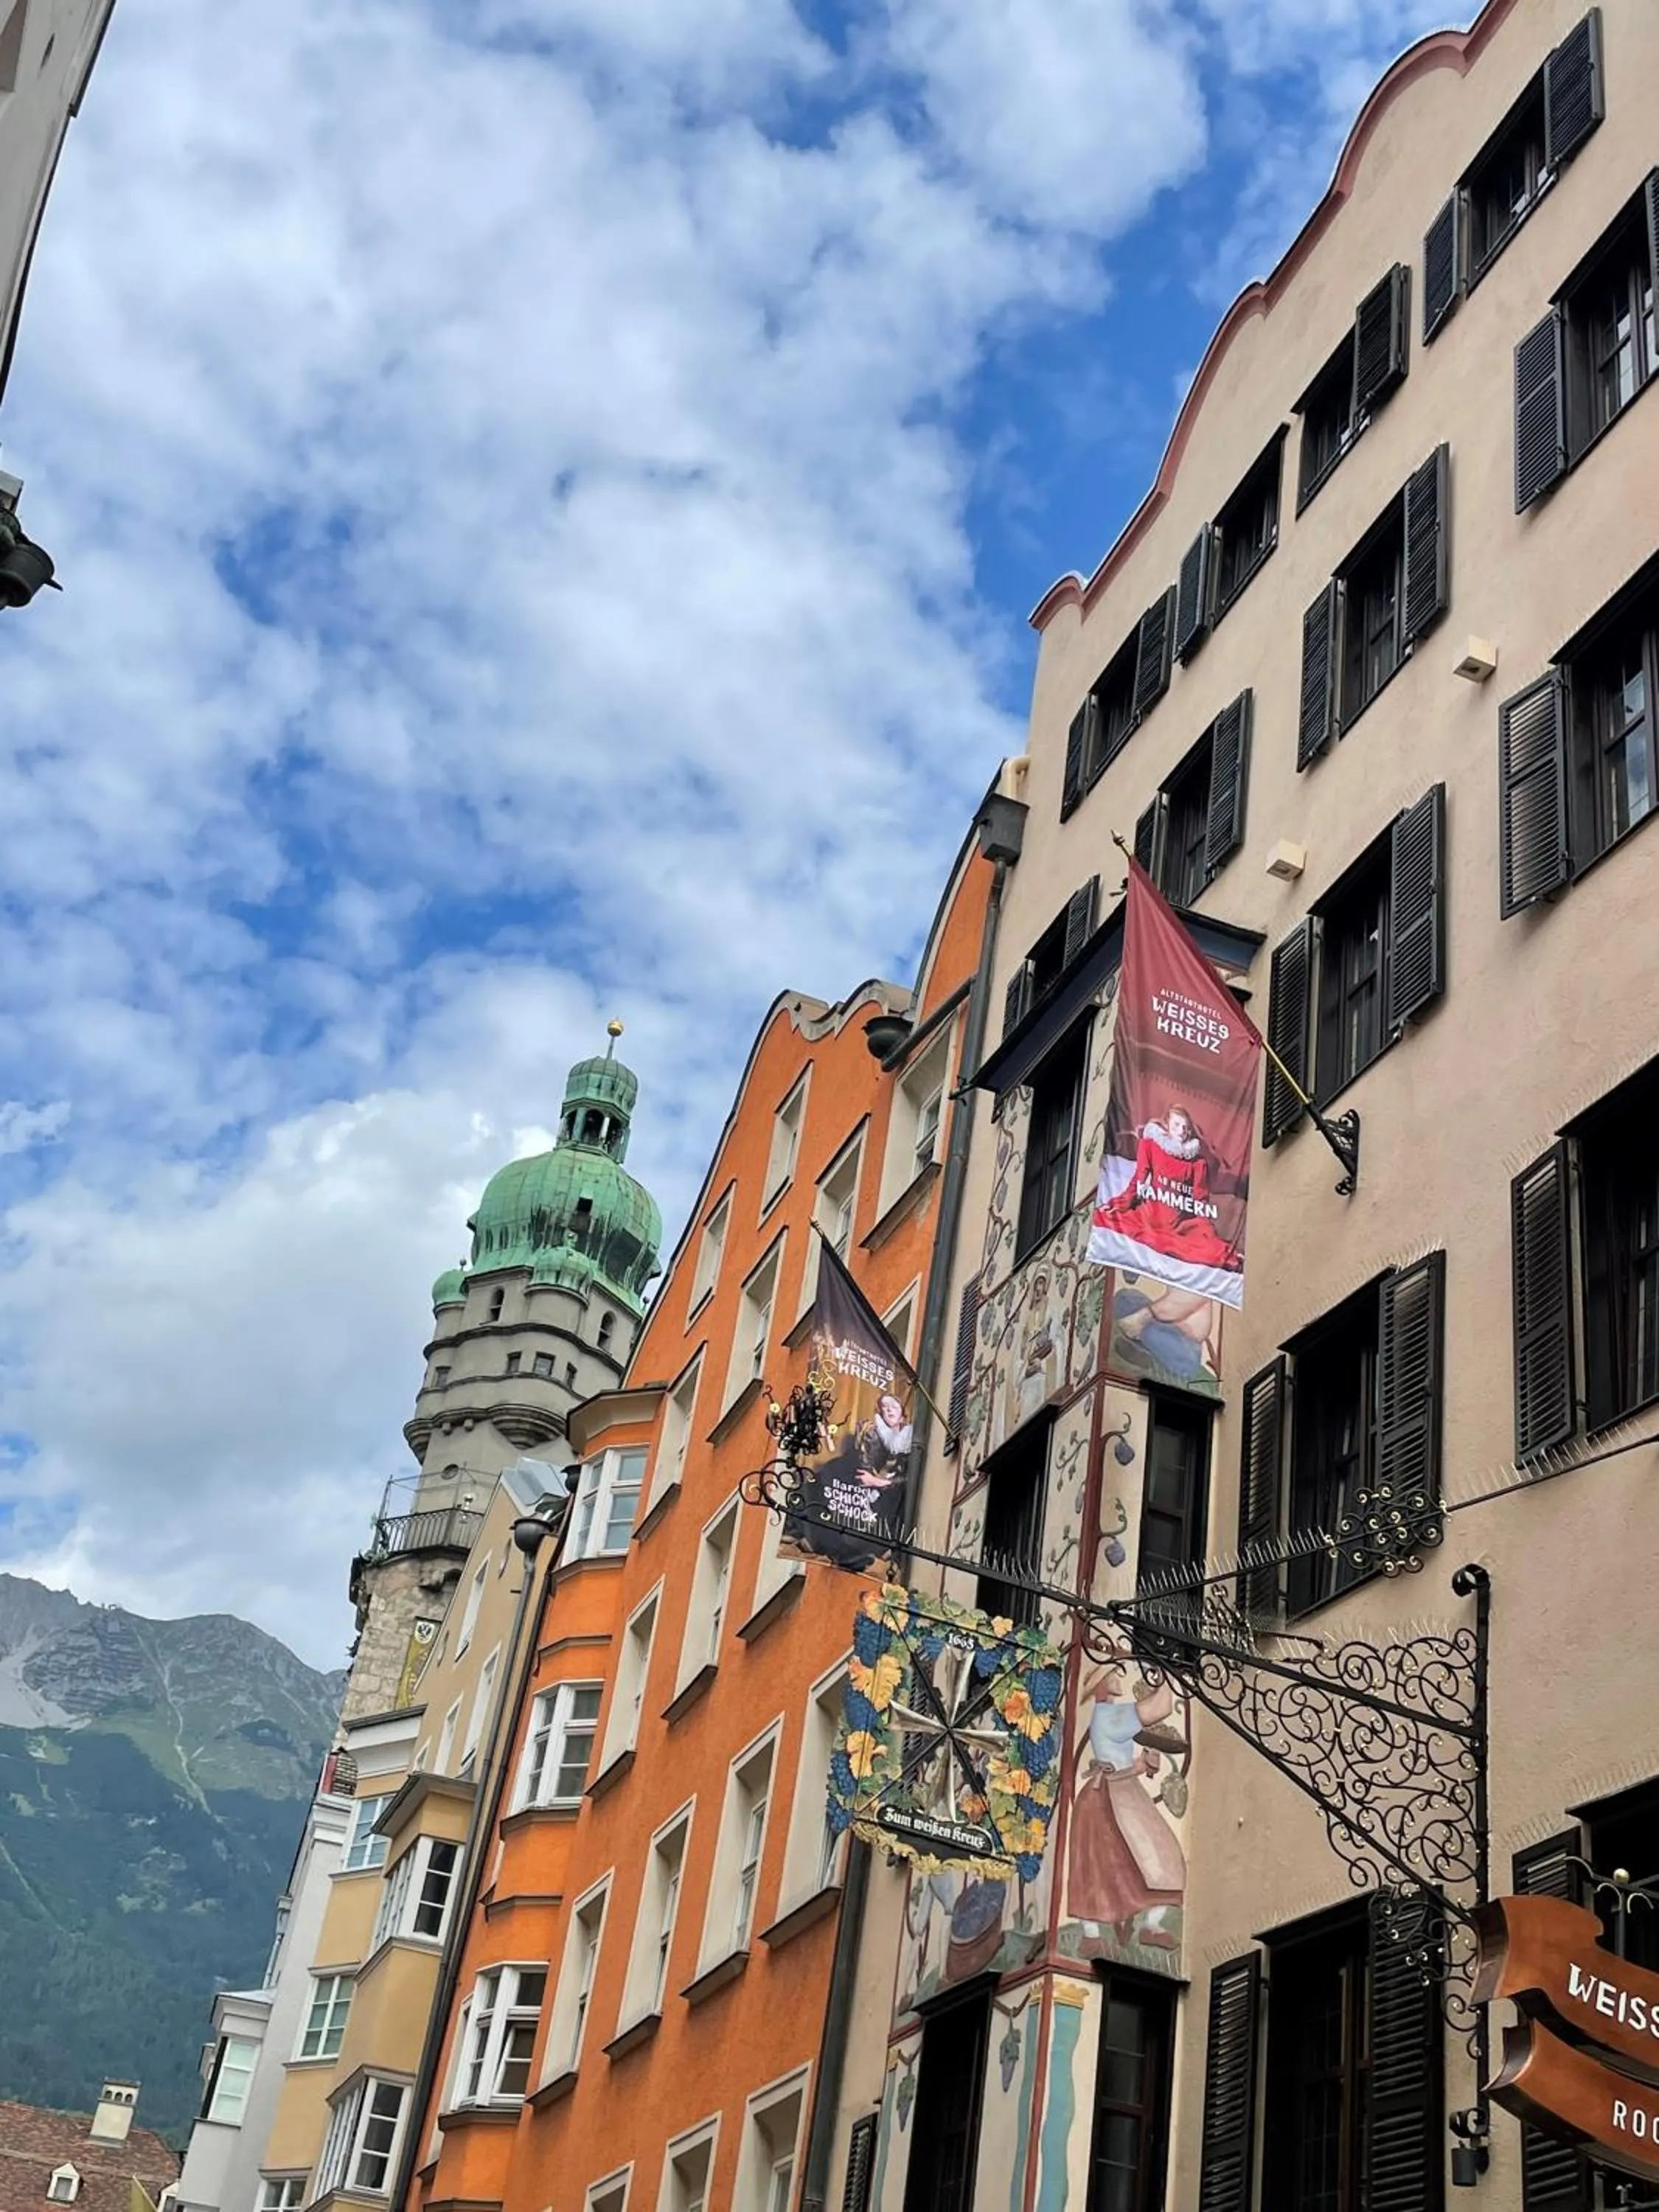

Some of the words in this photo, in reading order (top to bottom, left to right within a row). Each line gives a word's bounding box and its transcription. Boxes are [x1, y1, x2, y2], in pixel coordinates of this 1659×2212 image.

[1152, 995, 1229, 1039] WEISSES
[1157, 1016, 1220, 1054] KREUZ
[1136, 1179, 1218, 1219] KAMMERN
[835, 1346, 894, 1381] WEISSES
[838, 1360, 888, 1391] KREUZ
[824, 1486, 869, 1509] SCHICK
[827, 1499, 877, 1523] SCHOCK
[884, 1807, 911, 1827] Zum
